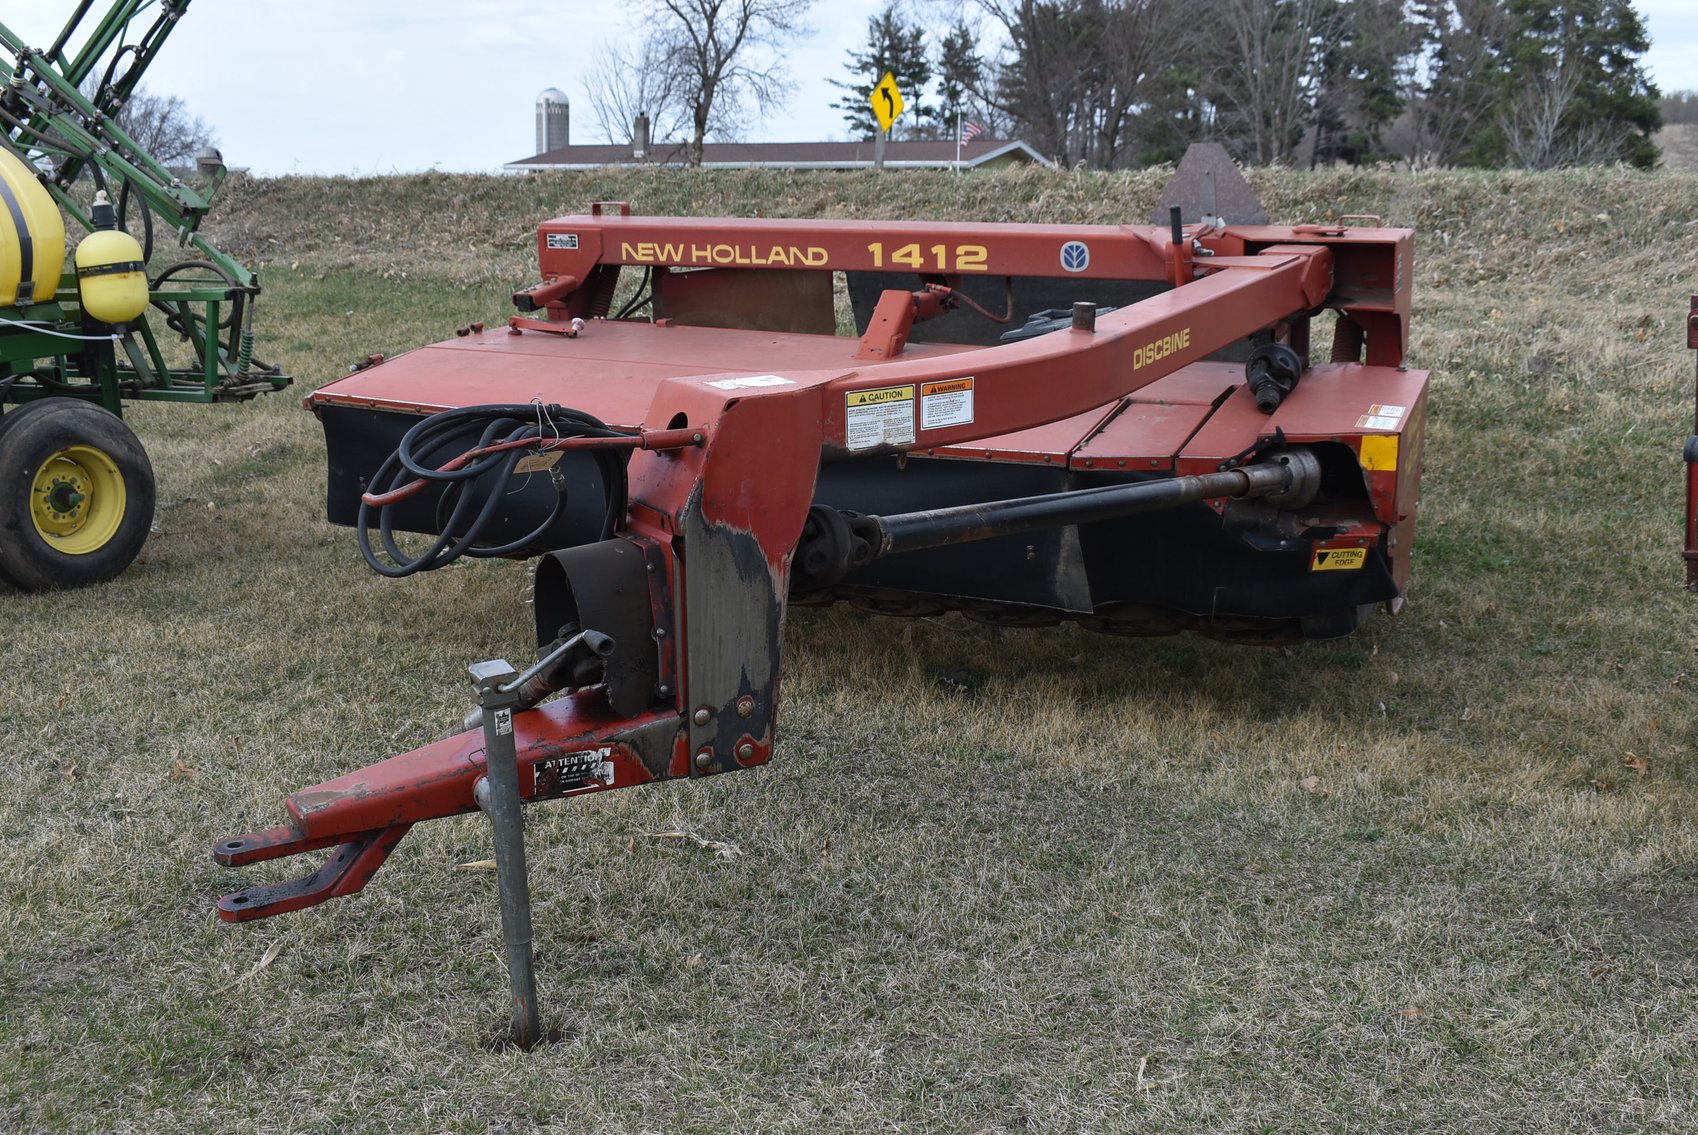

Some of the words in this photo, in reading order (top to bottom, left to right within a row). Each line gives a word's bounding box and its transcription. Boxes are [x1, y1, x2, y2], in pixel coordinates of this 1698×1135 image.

[622, 242, 684, 262] NEW
[691, 244, 829, 266] HOLLAND
[867, 242, 988, 271] 1412
[1133, 327, 1191, 371] DISCBINE
[868, 390, 903, 402] CAUTION
[937, 382, 966, 393] WARNING
[1331, 551, 1363, 559] CUTTING
